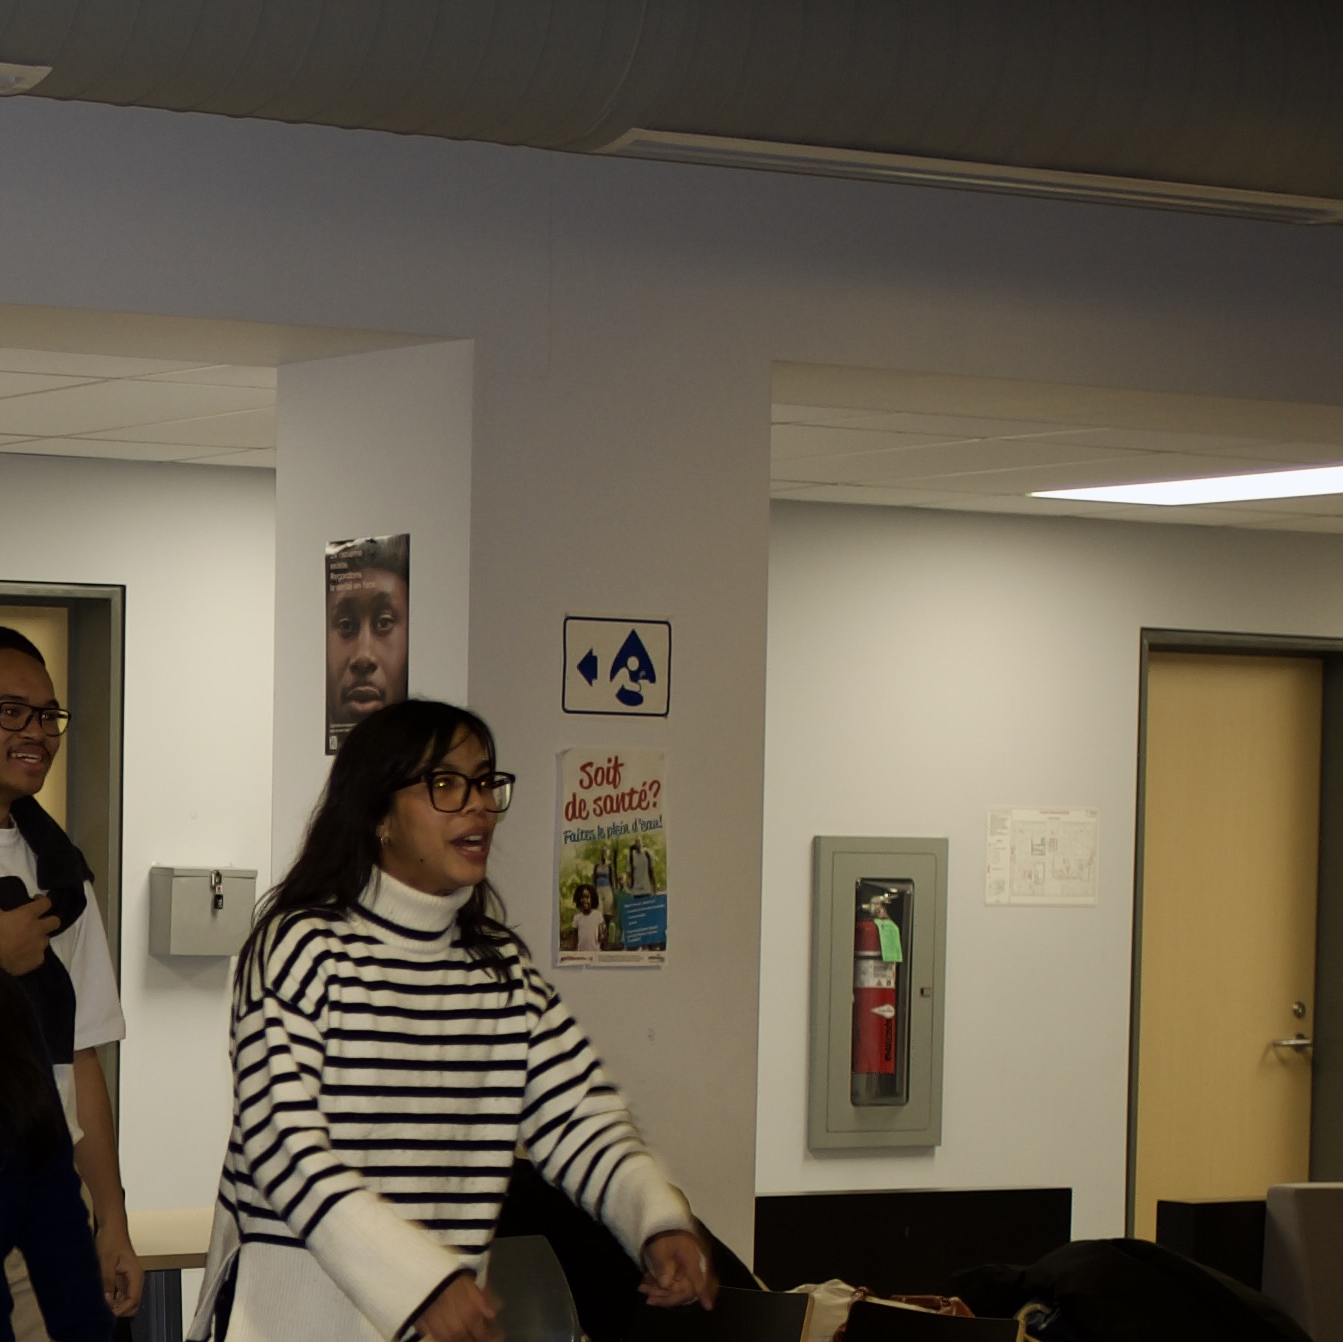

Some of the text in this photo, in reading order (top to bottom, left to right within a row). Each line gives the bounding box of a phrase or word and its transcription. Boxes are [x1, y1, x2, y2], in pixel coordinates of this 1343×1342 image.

[579, 756, 625, 790] Soif
[564, 780, 661, 822] de santé?
[563, 828, 595, 845] Faites
[607, 821, 629, 840] plein
